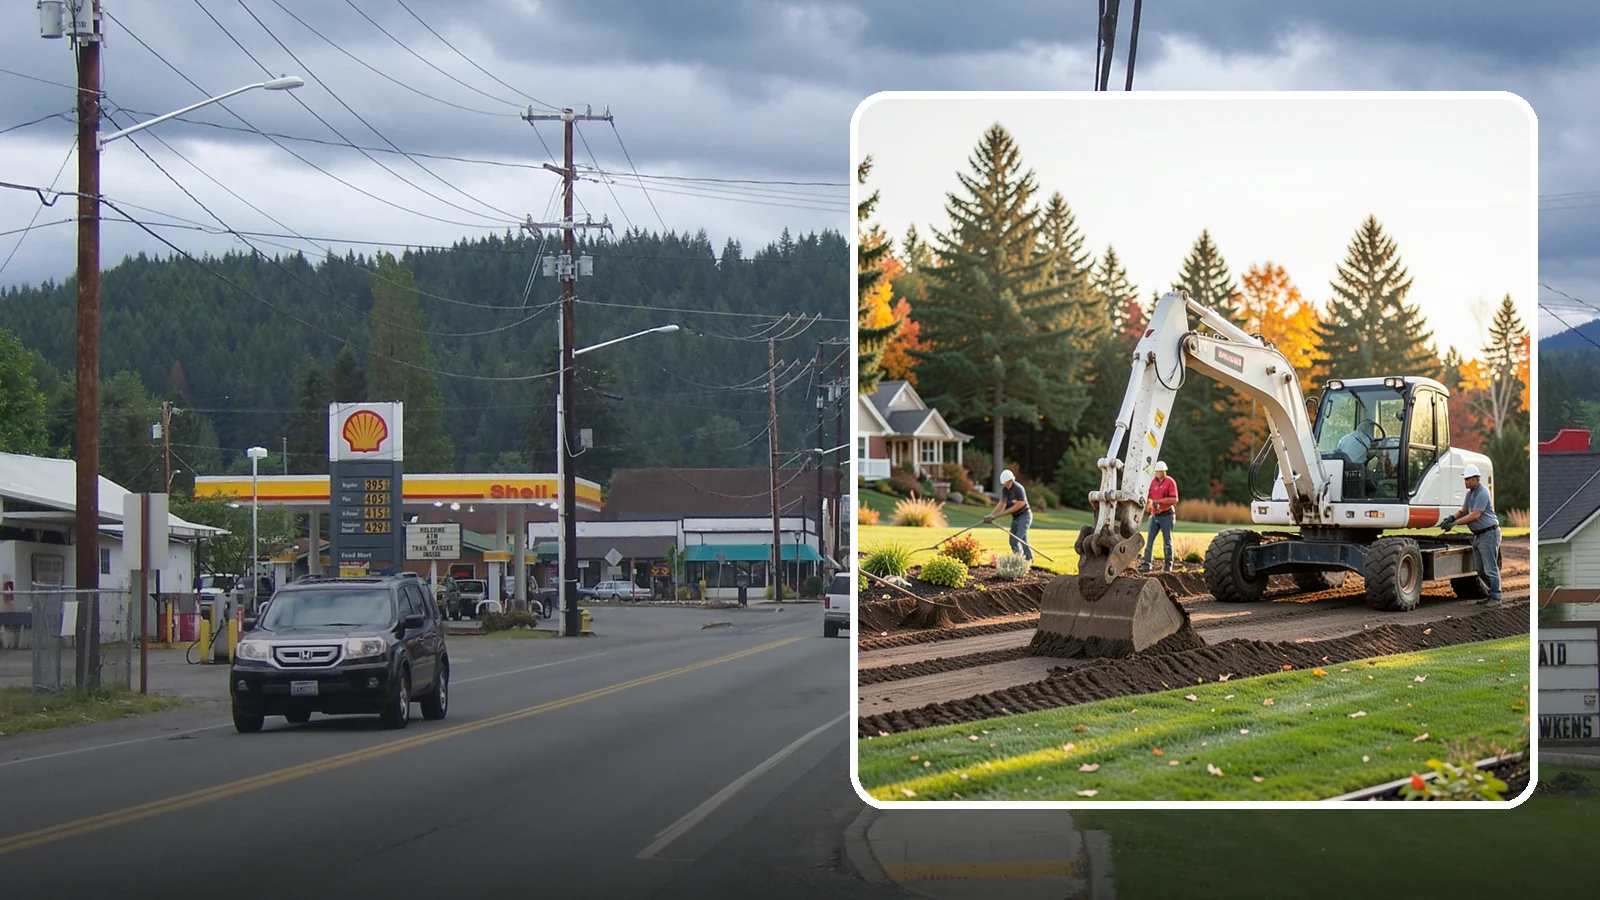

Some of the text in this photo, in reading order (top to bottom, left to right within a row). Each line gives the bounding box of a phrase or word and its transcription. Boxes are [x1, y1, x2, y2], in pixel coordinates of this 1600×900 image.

[366, 480, 384, 490] 395
[490, 484, 547, 499] Shell
[366, 494, 384, 504] 405
[366, 508, 384, 518] 415
[366, 522, 384, 533] 429
[1538, 642, 1566, 665] AID
